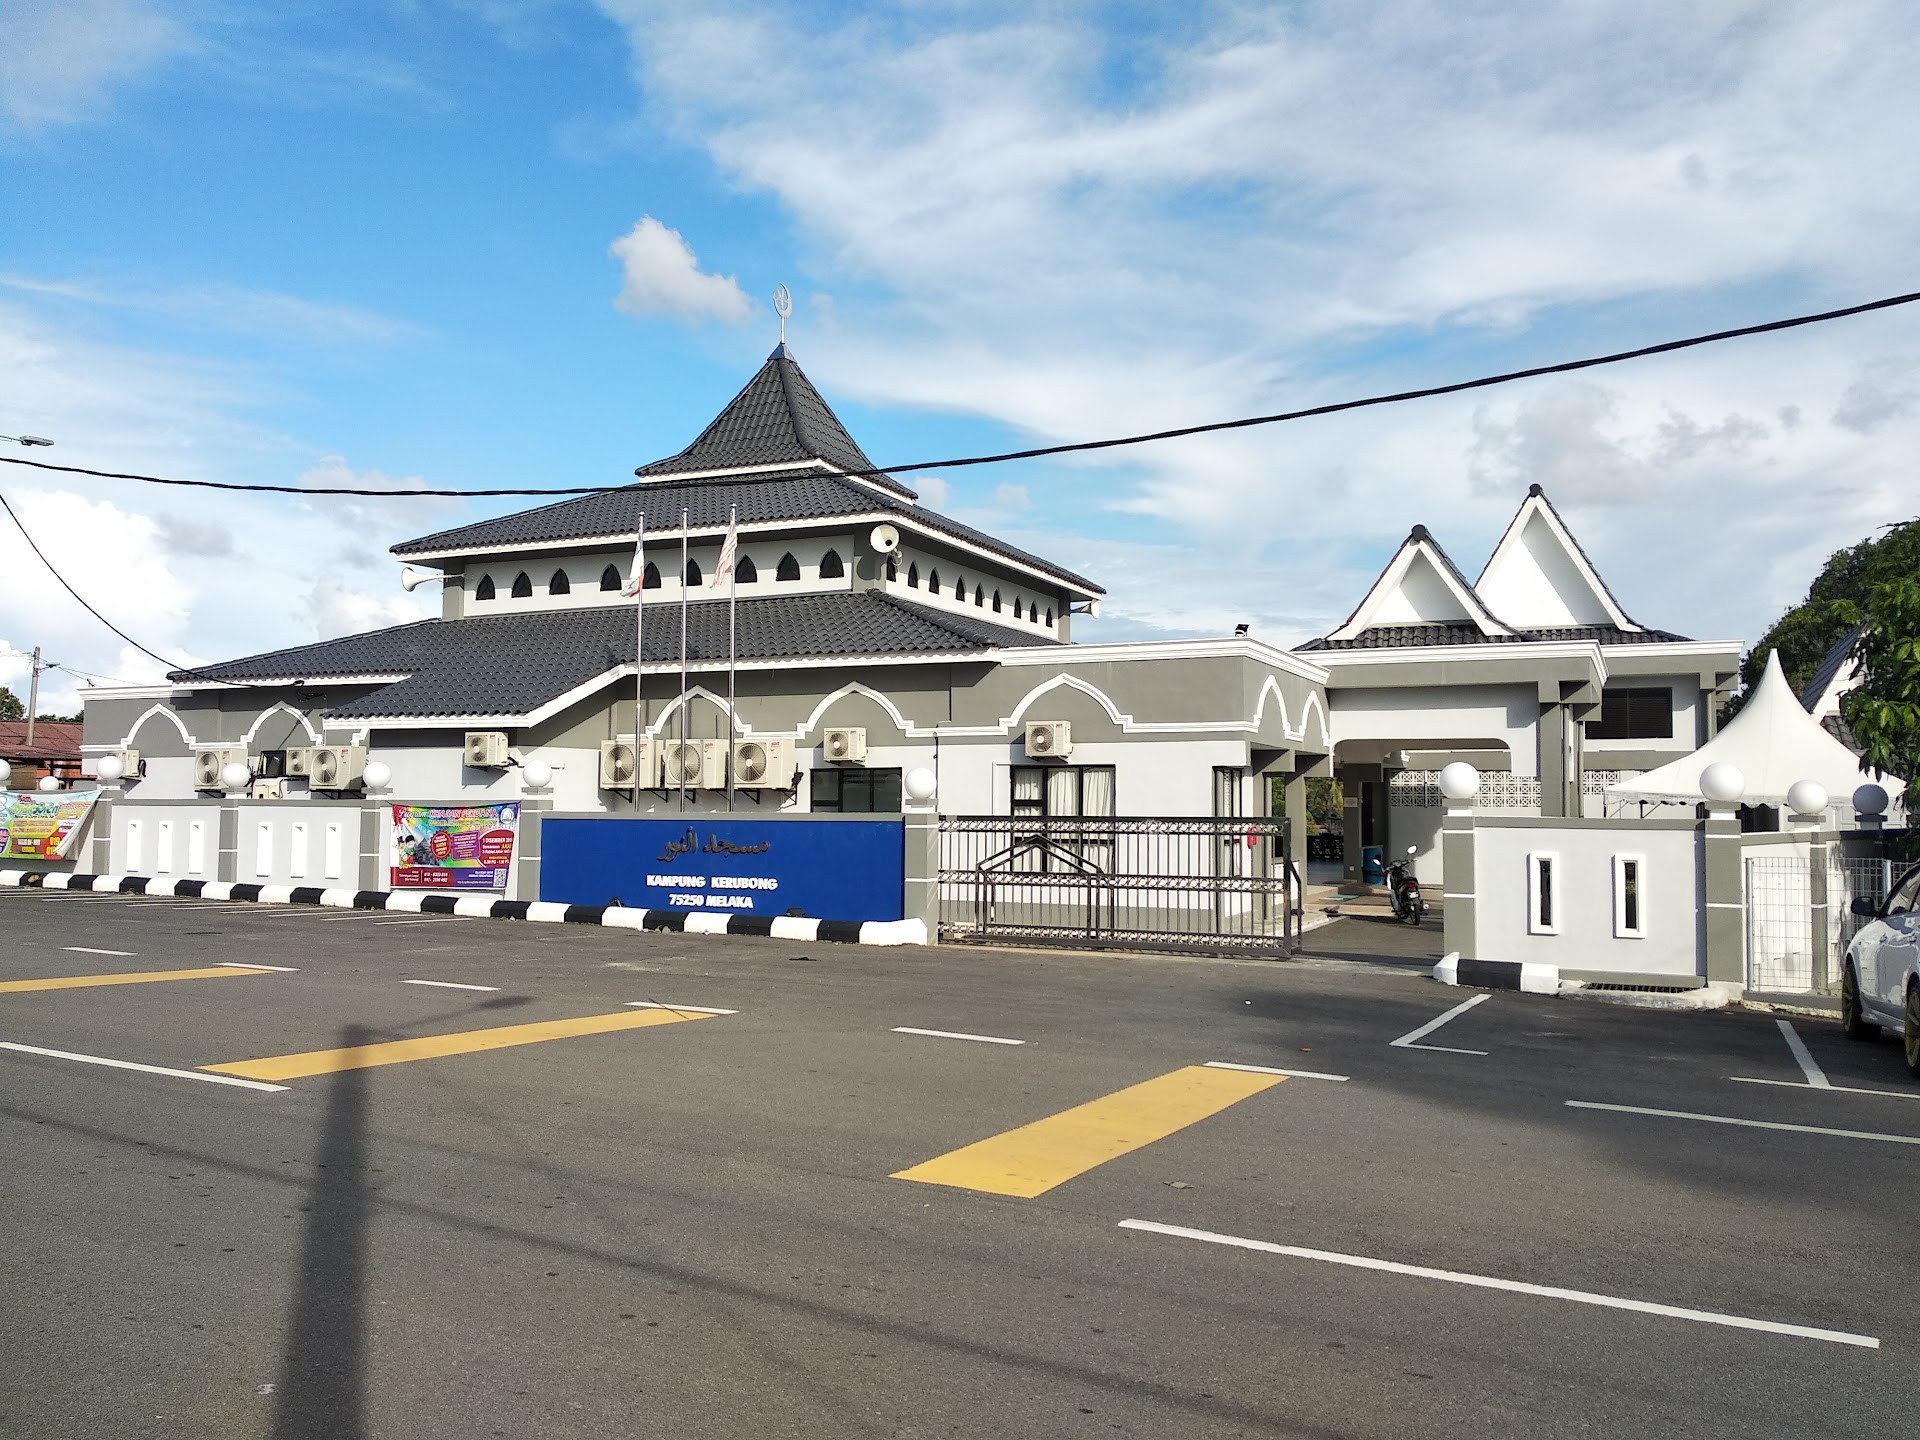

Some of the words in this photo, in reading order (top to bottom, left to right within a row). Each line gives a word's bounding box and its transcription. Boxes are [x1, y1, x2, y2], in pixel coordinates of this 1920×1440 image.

[703, 833, 770, 858] مسجد
[646, 875, 706, 887] KAMPUNG
[711, 877, 778, 890] KERUBONG
[669, 894, 704, 907] 75250
[706, 895, 753, 908] MELAKA
